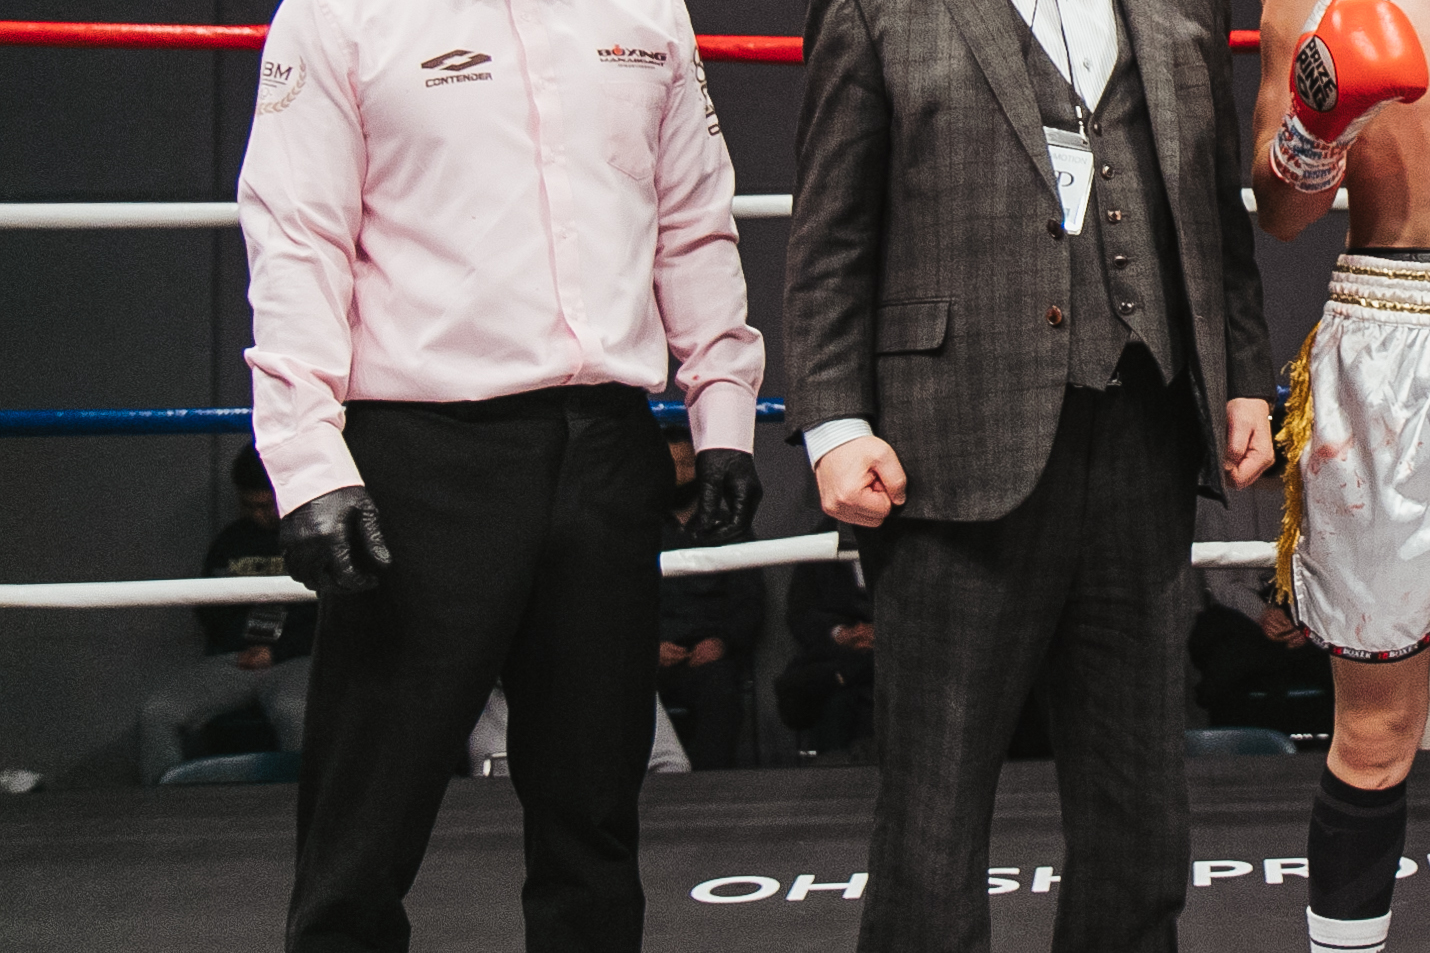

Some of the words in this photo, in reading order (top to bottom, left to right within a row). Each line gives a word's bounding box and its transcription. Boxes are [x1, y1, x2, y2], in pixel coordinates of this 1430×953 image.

[262, 61, 294, 81] BM
[425, 72, 493, 88] CONTENDER
[1296, 49, 1328, 110] RING
[1305, 36, 1338, 99] PRIZE
